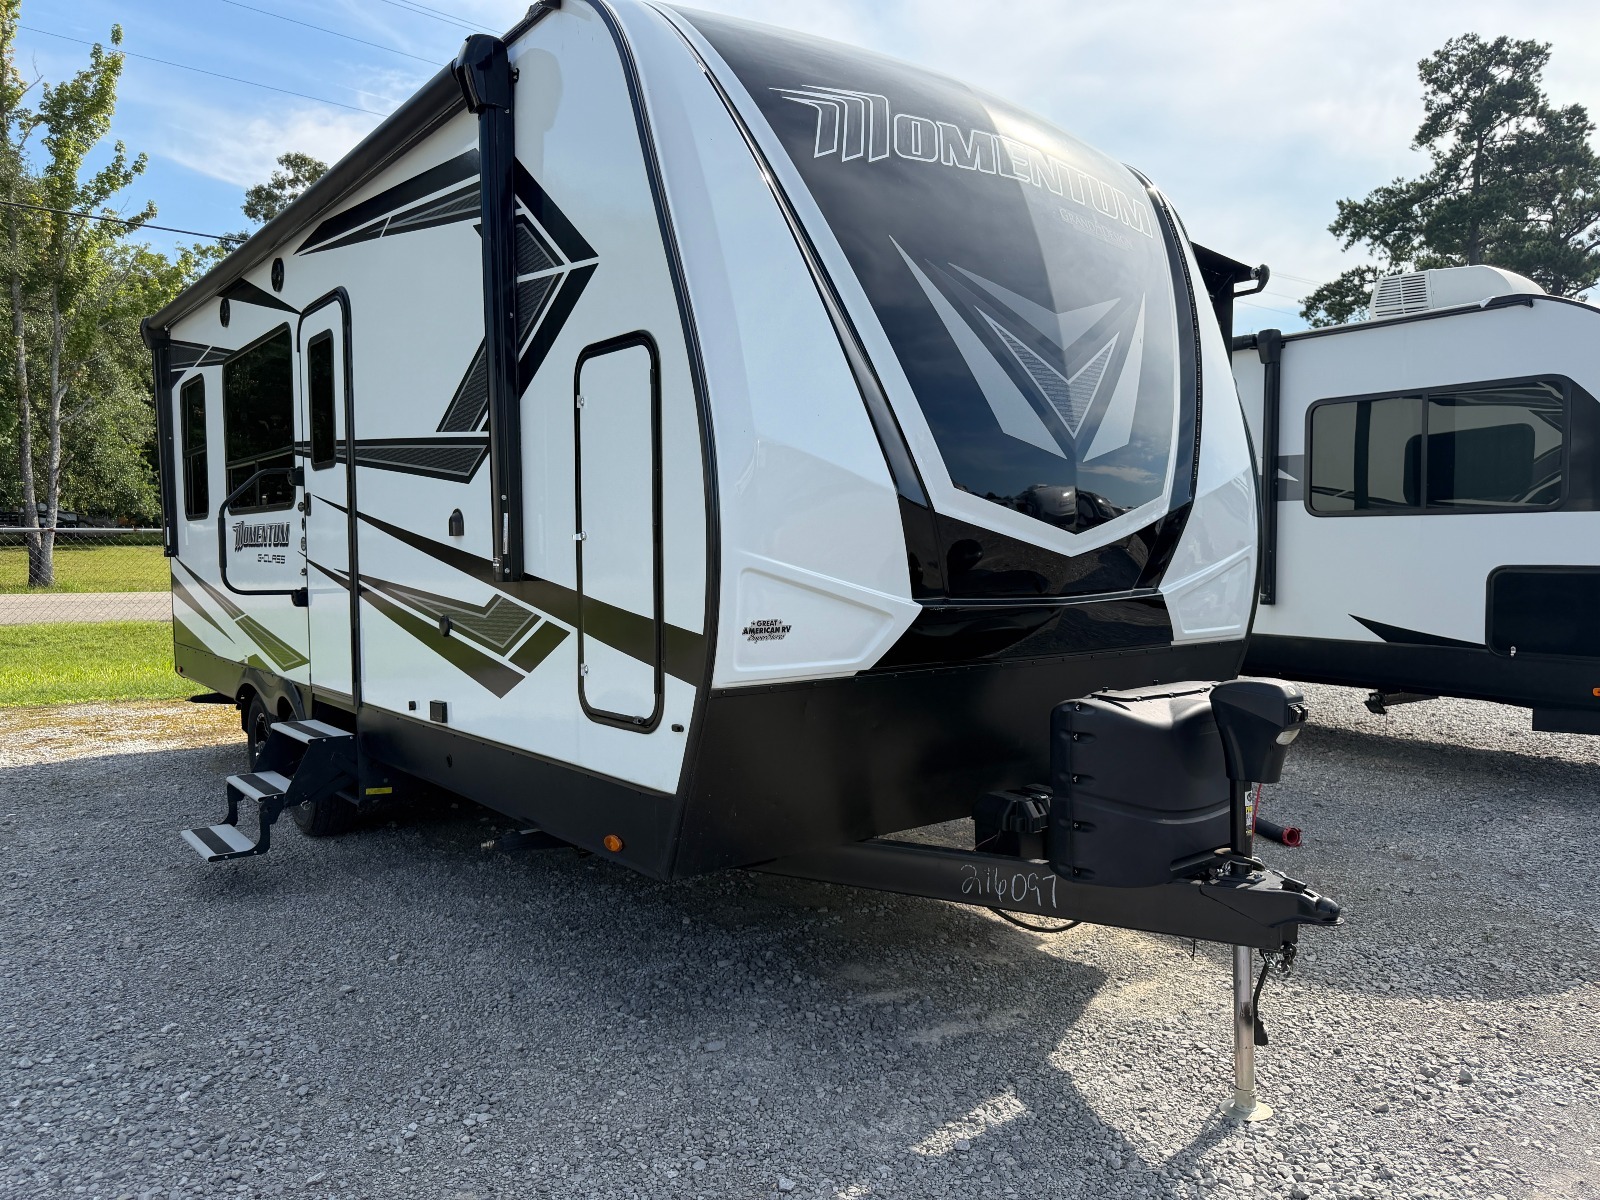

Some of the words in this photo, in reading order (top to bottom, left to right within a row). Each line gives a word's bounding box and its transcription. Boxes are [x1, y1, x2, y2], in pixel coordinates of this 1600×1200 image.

[769, 84, 1154, 239] MOMENTUM
[232, 520, 291, 552] MOMENTUM
[742, 626, 781, 635] AMERICAN
[960, 864, 1057, 909] 216097
